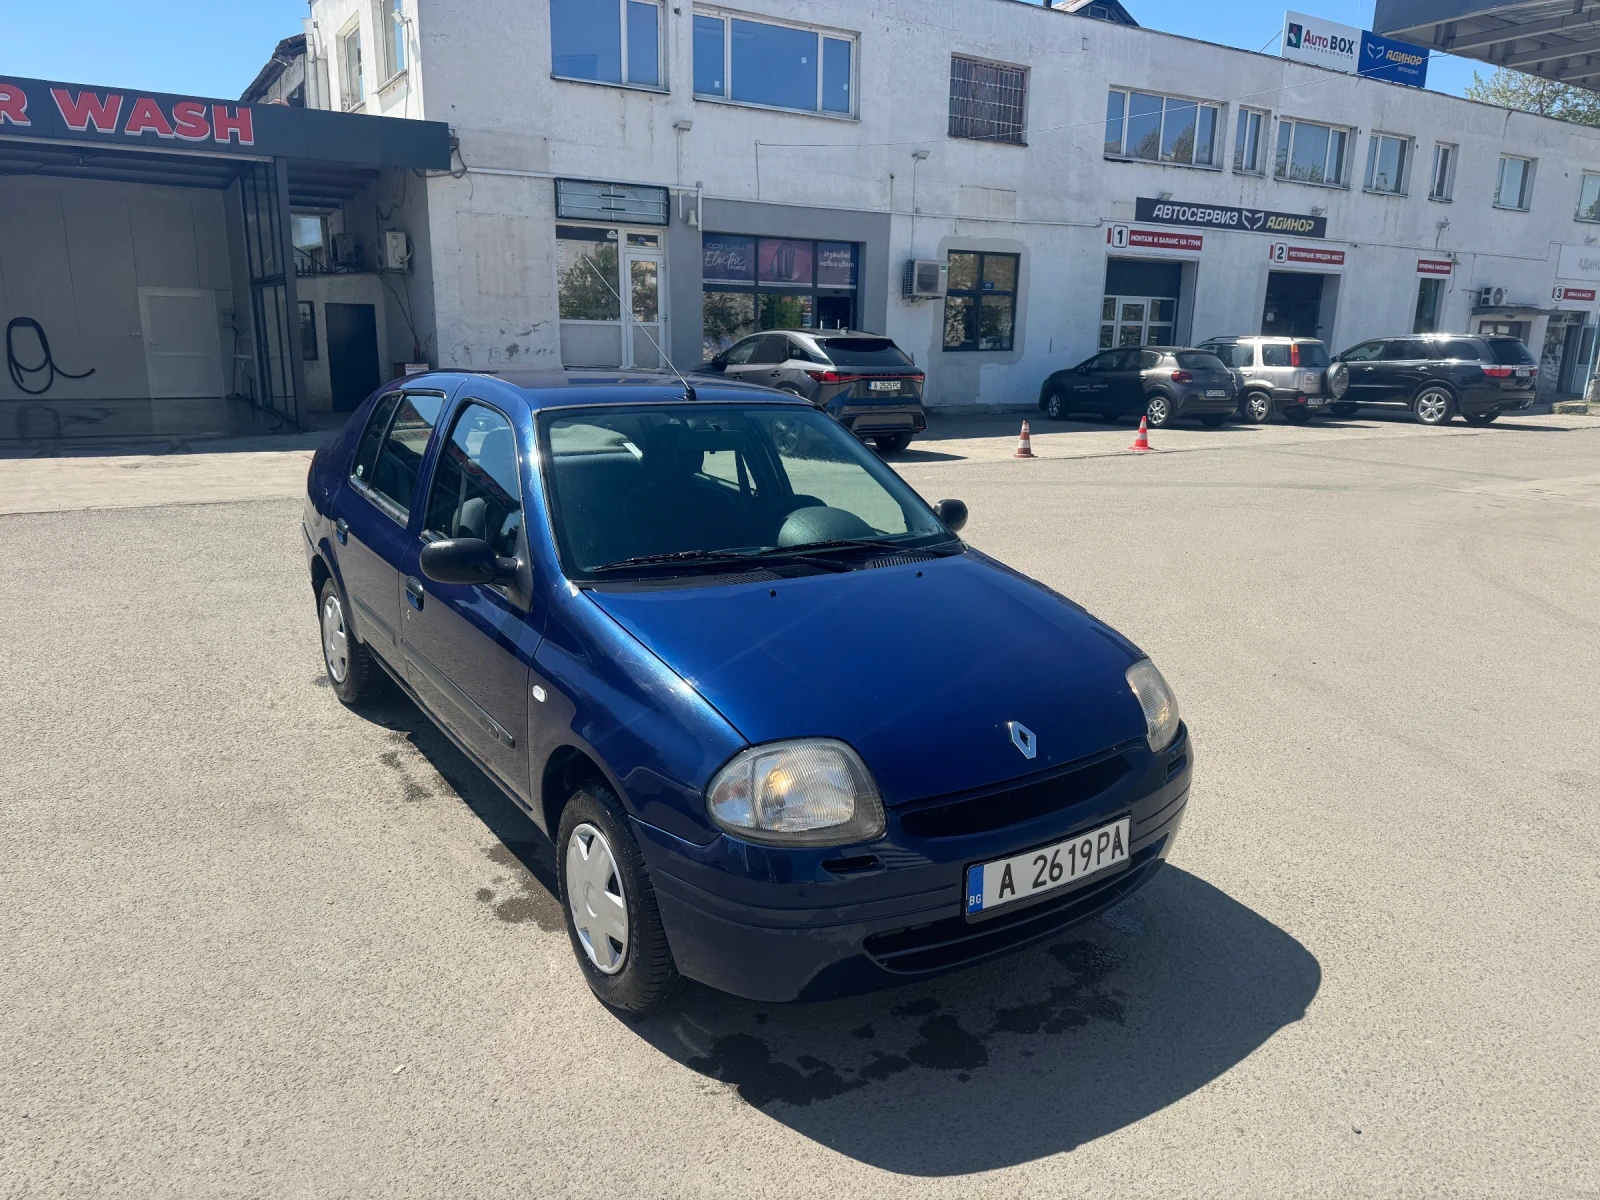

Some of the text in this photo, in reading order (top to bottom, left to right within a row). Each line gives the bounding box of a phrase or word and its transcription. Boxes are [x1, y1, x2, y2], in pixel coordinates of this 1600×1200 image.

[1329, 35, 1355, 55] BOX
[1328, 50, 1354, 60] SERVICE
[1385, 50, 1423, 66] АДИНОР
[50, 87, 254, 145] WASH
[1152, 204, 1314, 232] АВТОСЕРВИЗ АДИНОР
[1117, 229, 1123, 245] 1
[1159, 237, 1179, 245] БАЛАНС
[1180, 238, 1187, 246] НА
[1187, 239, 1201, 247] ГУМИ
[823, 250, 851, 259] Изживей
[1277, 246, 1284, 259] 2
[704, 250, 746, 270] Electric
[819, 259, 838, 267] новия
[1556, 287, 1563, 299] 3
[999, 825, 1125, 899] A 2619PA
[969, 894, 982, 906] BG
